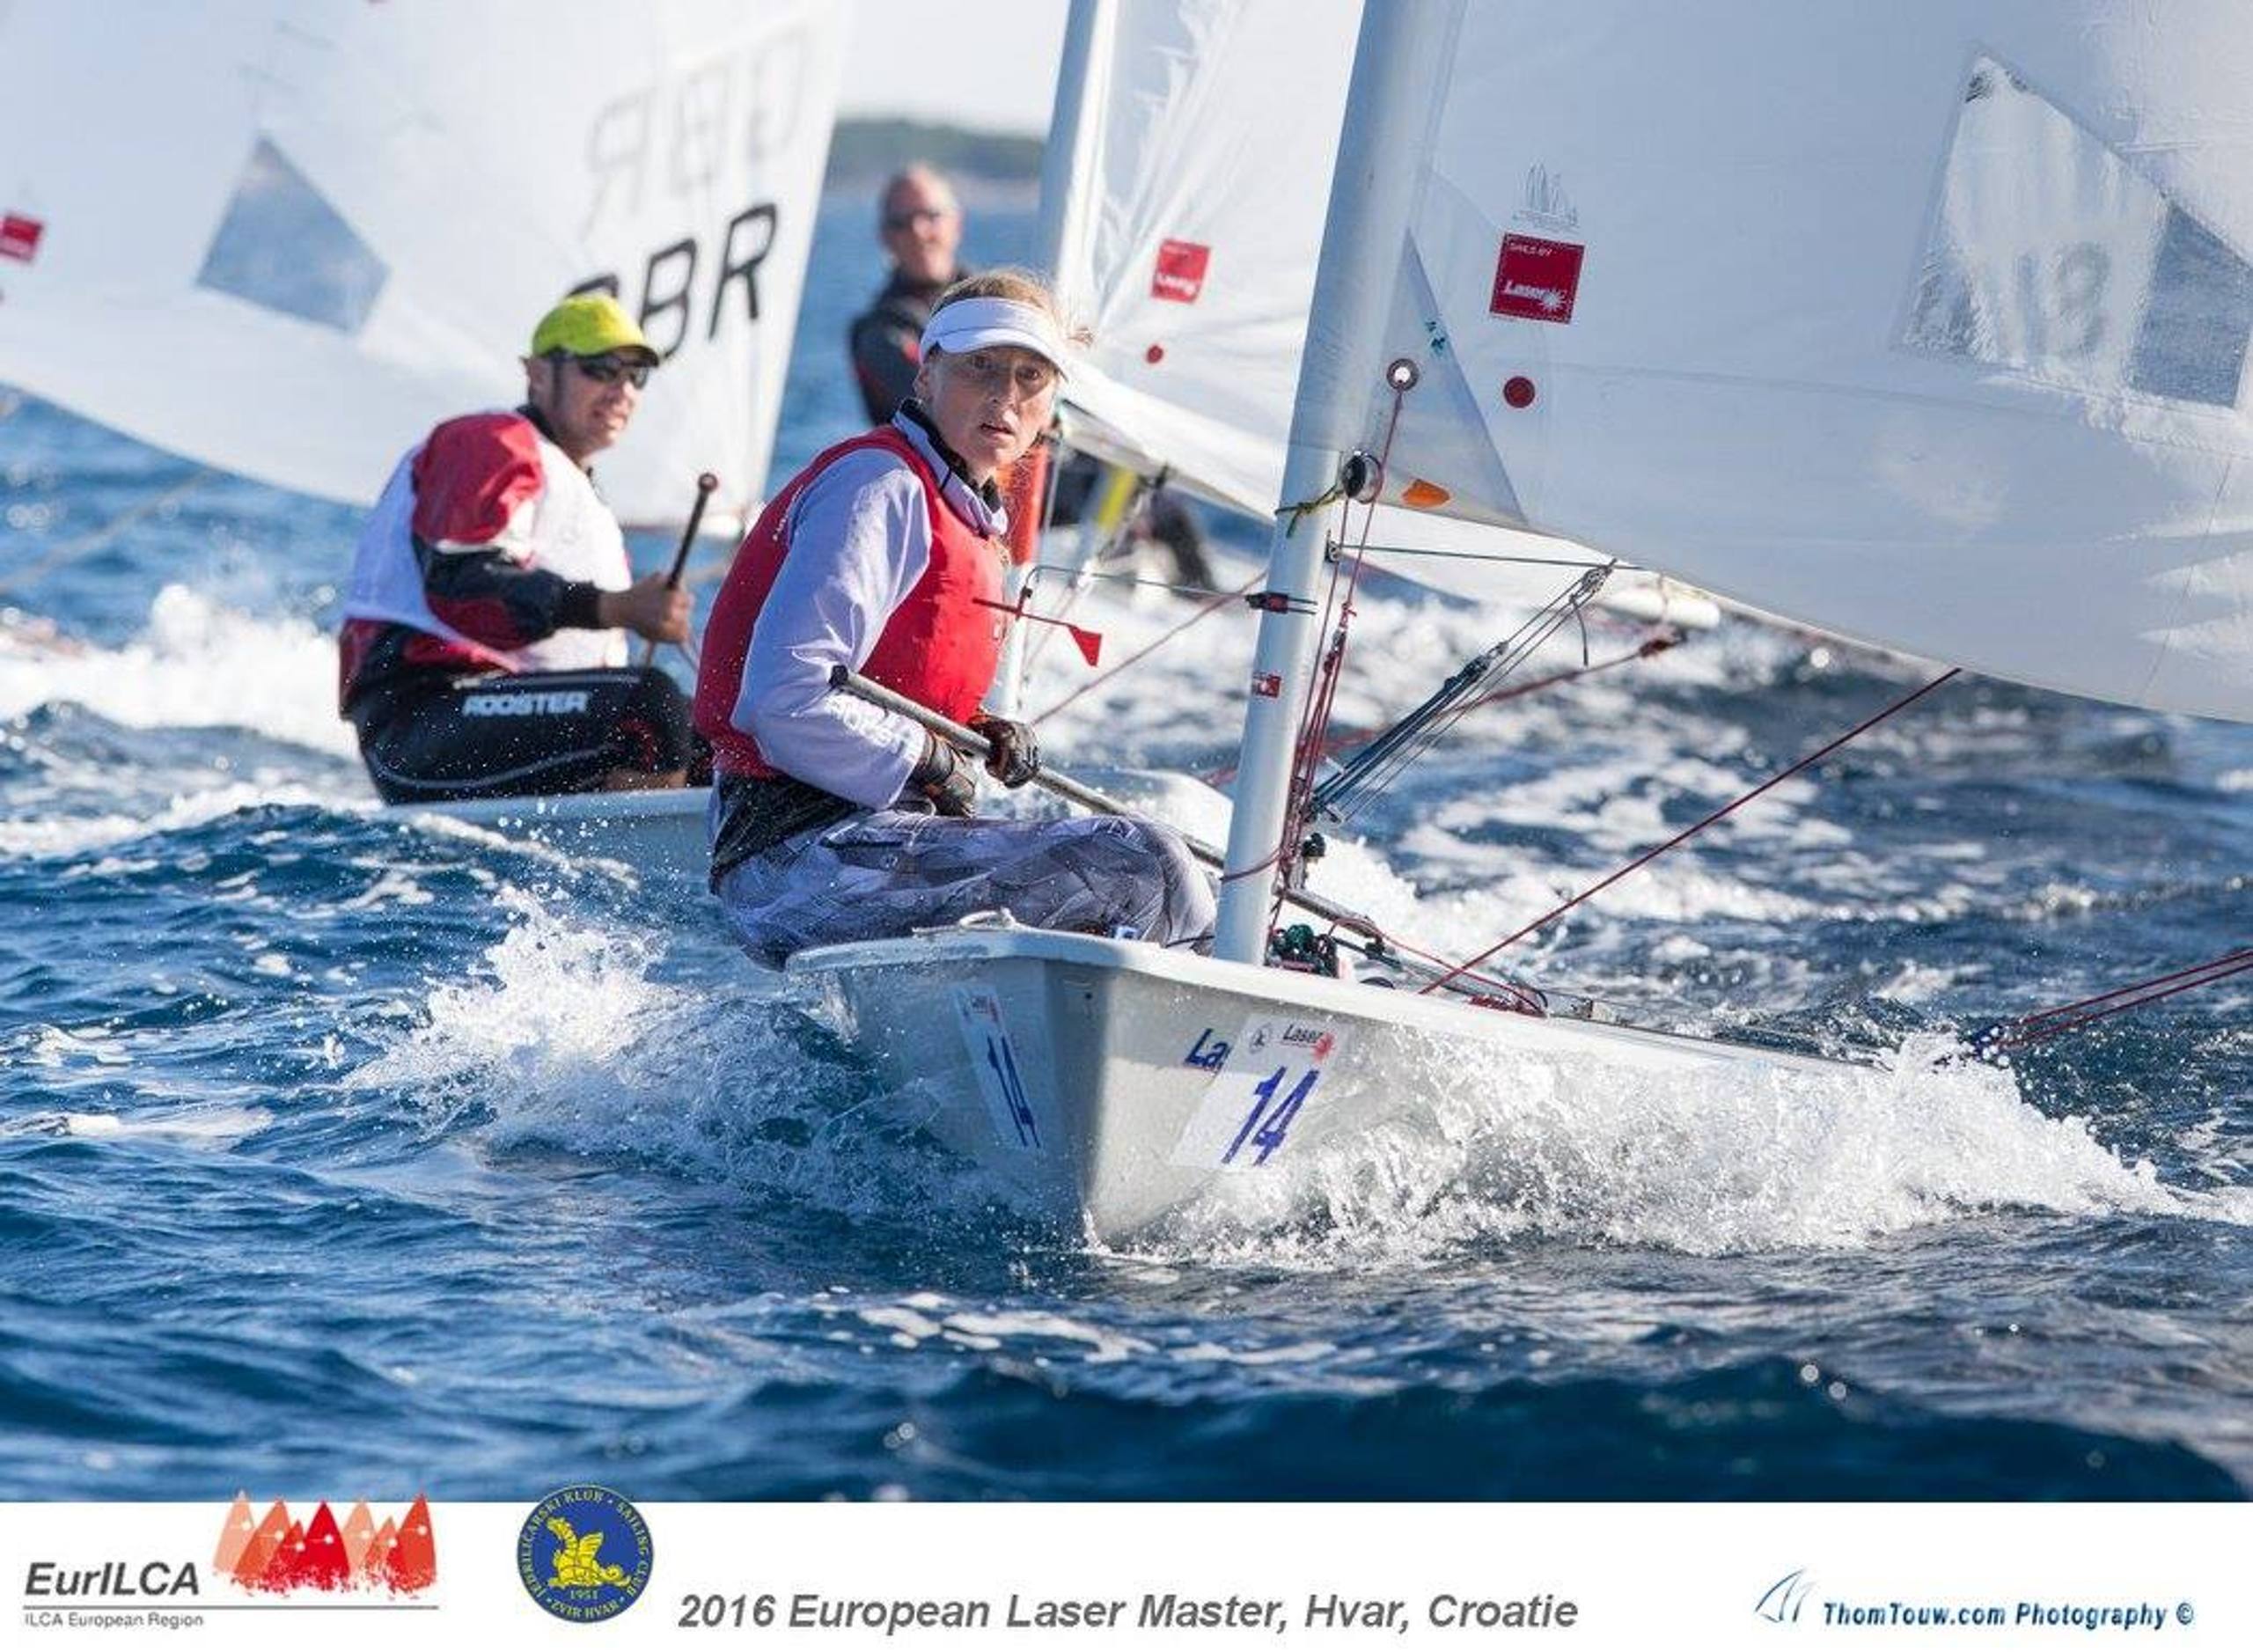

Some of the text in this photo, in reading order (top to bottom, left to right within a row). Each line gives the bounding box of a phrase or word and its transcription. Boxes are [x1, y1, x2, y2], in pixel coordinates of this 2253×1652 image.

[567, 203, 777, 359] BR
[1183, 1027, 1232, 1070] La
[1282, 1024, 1323, 1046] Laser
[987, 1034, 1040, 1149] 14
[1221, 1066, 1320, 1167] 14
